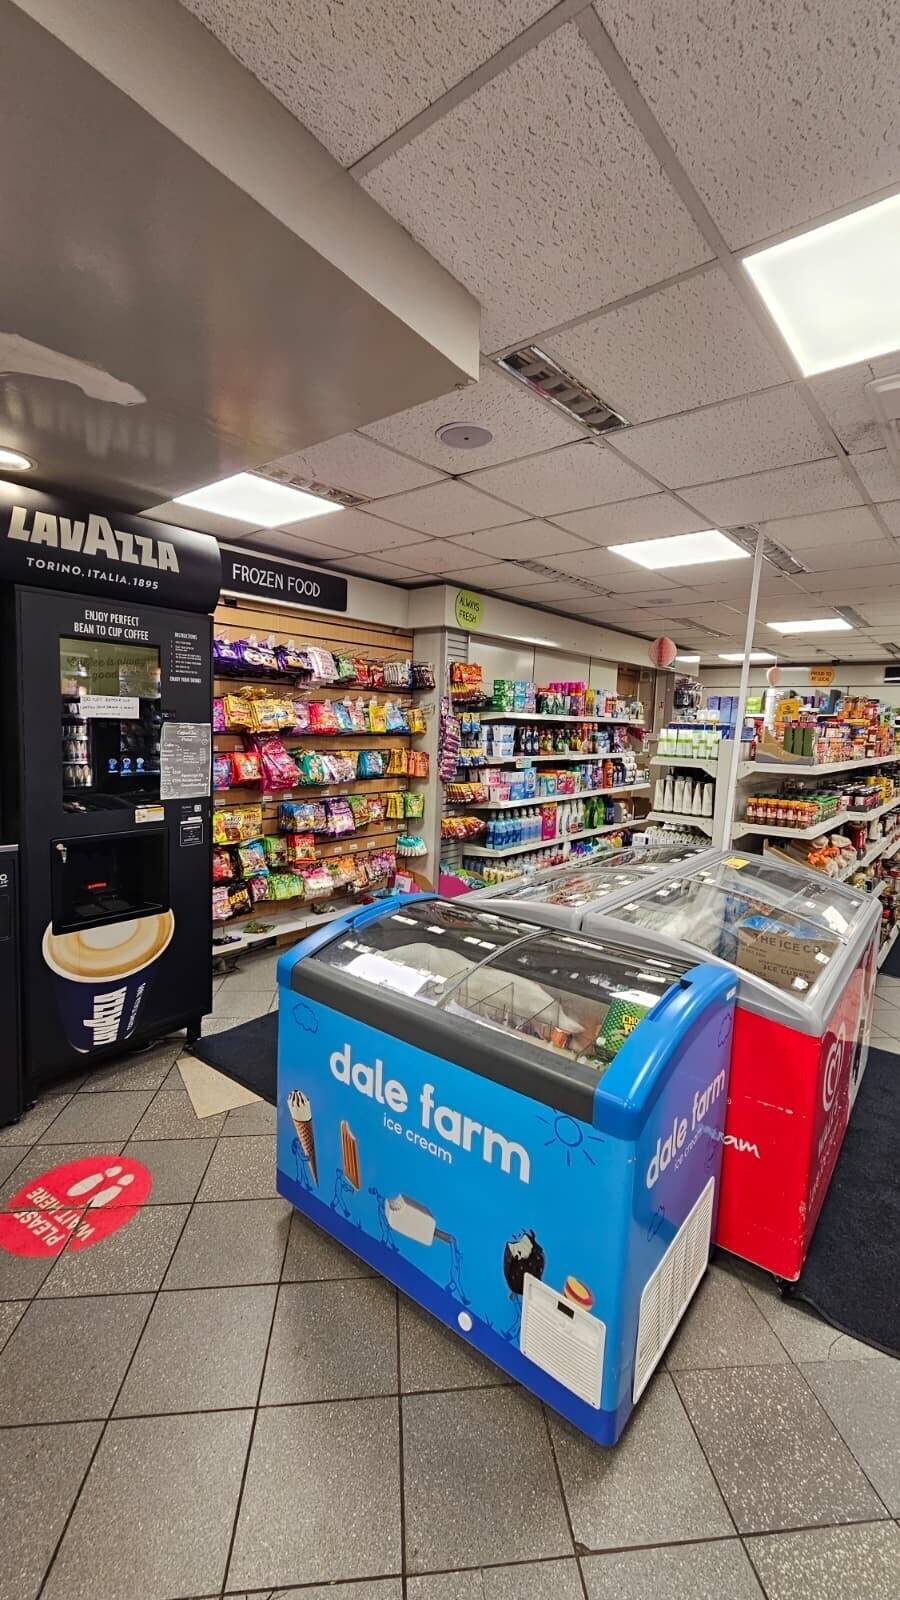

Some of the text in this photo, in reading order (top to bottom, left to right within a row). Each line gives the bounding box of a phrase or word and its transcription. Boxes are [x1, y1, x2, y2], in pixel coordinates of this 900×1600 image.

[7, 506, 180, 573] LAVAZZA
[232, 563, 321, 598] FROZEN FOOD
[84, 609, 140, 627] ENJOY PERFECT
[459, 597, 480, 612] ALWAYS
[459, 610, 477, 623] FRESH
[73, 622, 149, 641] BEAN TO CUP COFFEE
[779, 941, 800, 952] ICE
[763, 964, 777, 973] ICE
[83, 986, 128, 1046] LAVAZZA
[329, 1043, 531, 1184] dale farm
[646, 1068, 726, 1189] dale farm
[383, 1112, 453, 1165] ice cream
[12, 1210, 66, 1247] PLEASE
[26, 1187, 97, 1242] WAIT HERE
